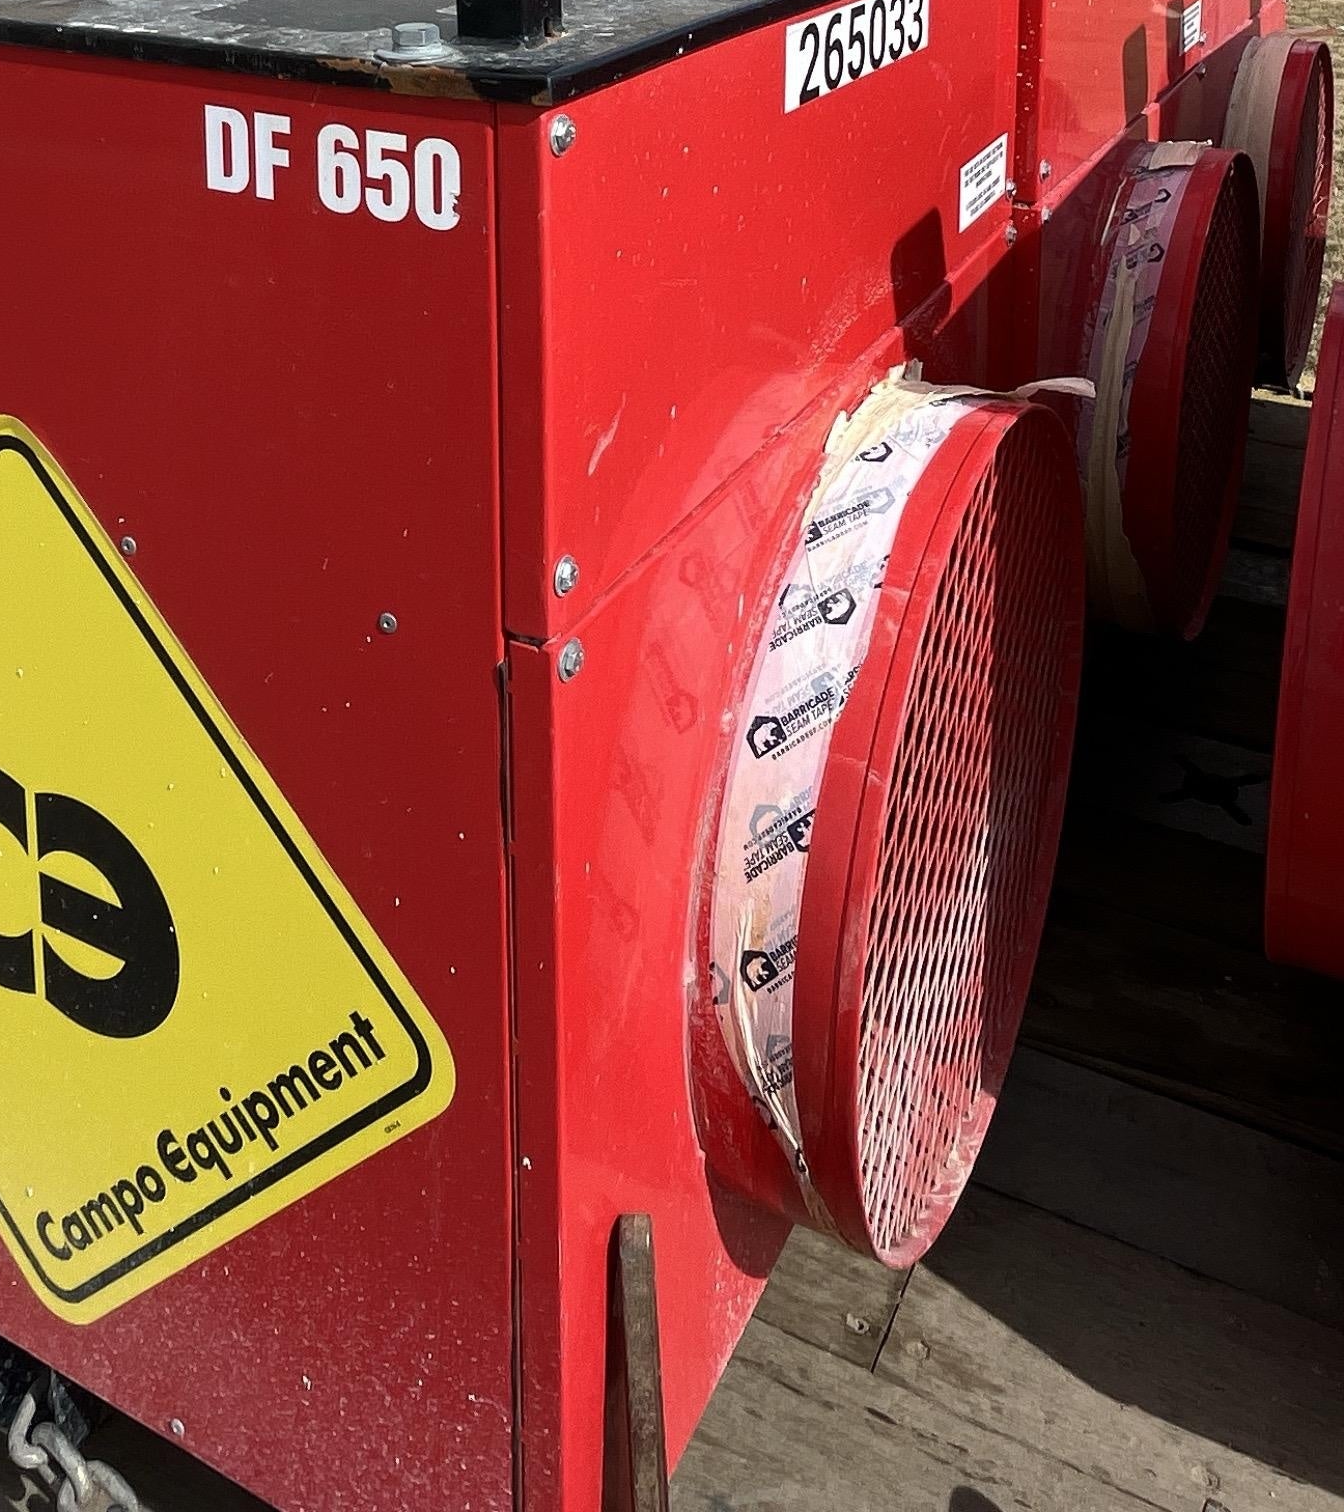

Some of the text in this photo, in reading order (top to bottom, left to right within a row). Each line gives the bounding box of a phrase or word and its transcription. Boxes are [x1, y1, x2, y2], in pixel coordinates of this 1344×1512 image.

[204, 104, 462, 231] DF 650
[769, 614, 823, 653] BARRICADE
[780, 686, 836, 727] BARRICADE
[785, 714, 811, 738] SEAM
[744, 840, 796, 885] BARRICADE
[36, 1010, 387, 1261] Campo Equipment
